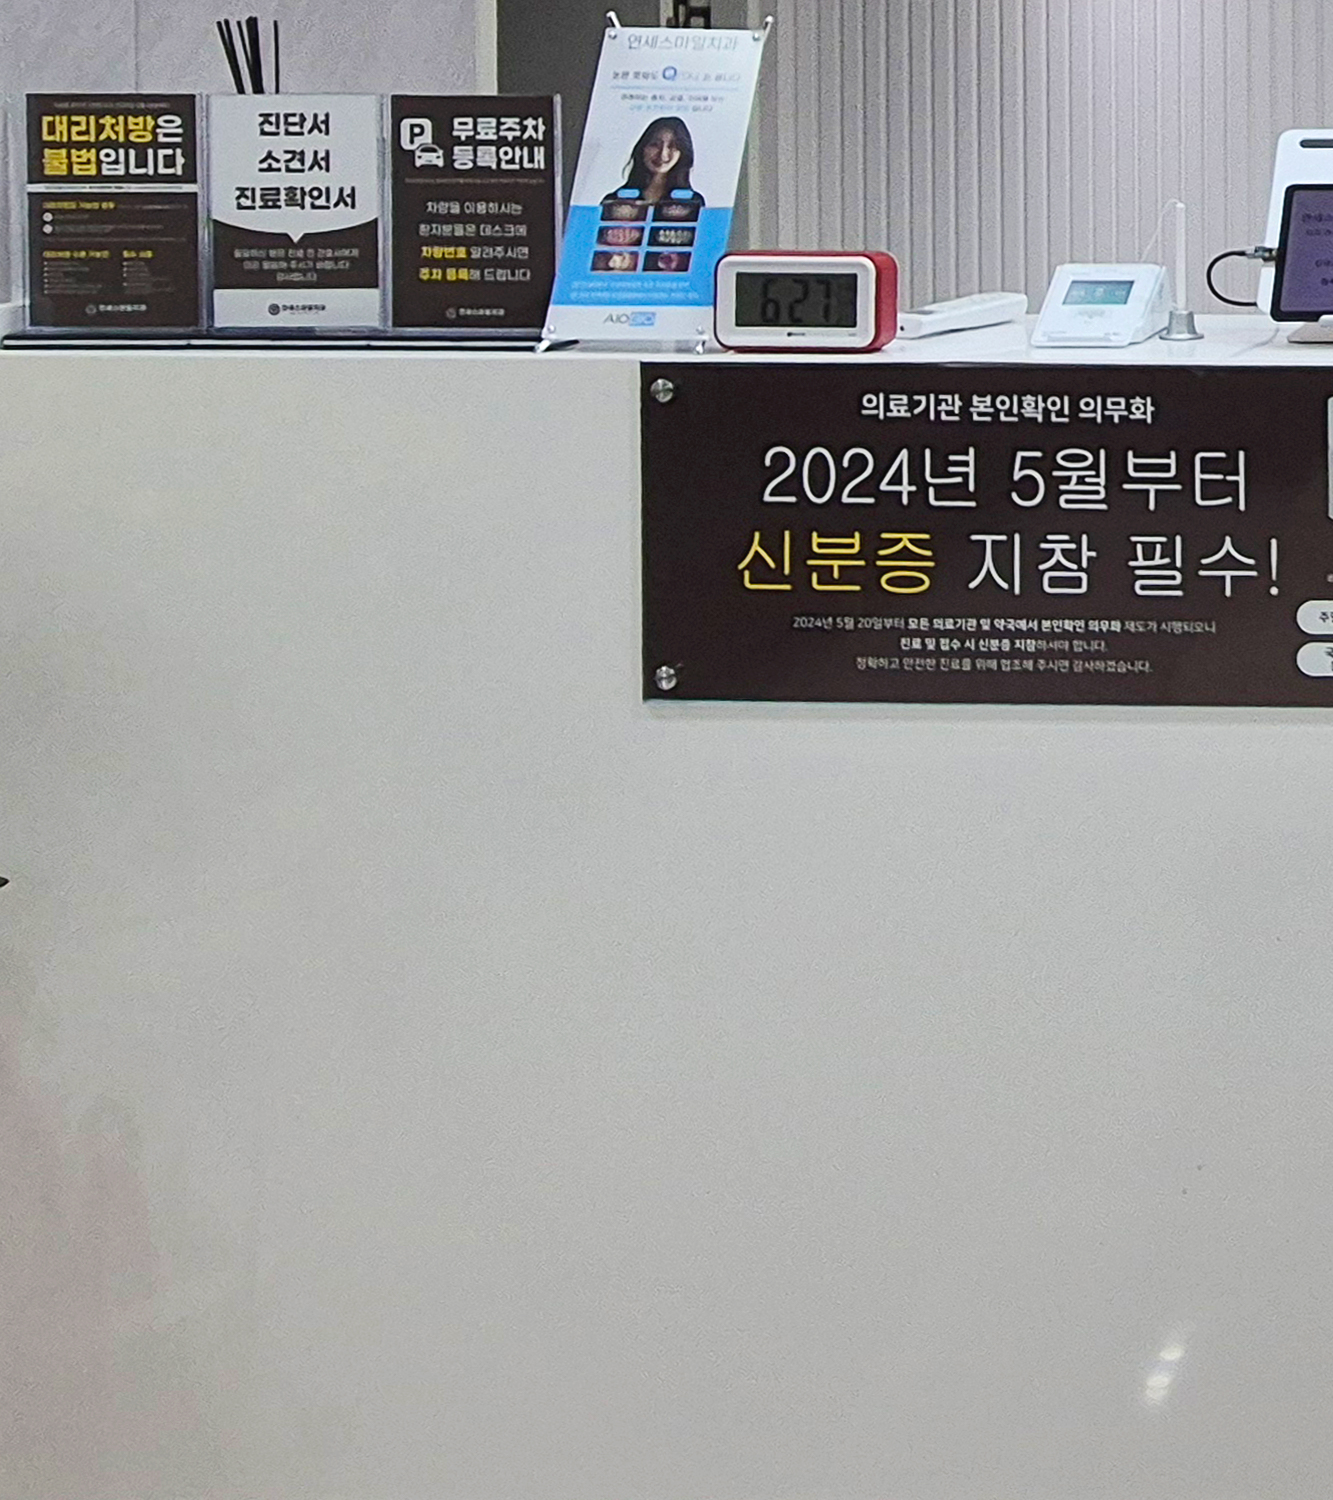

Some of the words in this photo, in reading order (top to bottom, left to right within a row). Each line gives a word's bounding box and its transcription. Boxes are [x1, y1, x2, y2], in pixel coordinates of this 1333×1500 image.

[628, 33, 738, 51] 연세스마일치과
[41, 115, 184, 143] 대리처방은
[257, 113, 330, 137] 진단서
[452, 116, 545, 141] 무료주차
[42, 148, 185, 176] 불법입니다
[257, 150, 330, 174] 소견서
[452, 144, 545, 171] 등록안내
[234, 185, 357, 211] 진료확인서
[421, 246, 467, 259] 차량번호
[484, 268, 530, 281] 드립니다
[861, 394, 961, 420] 의료기관
[969, 394, 1070, 423] 본인확인
[1078, 396, 1155, 424] 의무화
[762, 445, 977, 508] 2024년
[1010, 448, 1247, 511] 5월부터
[737, 530, 936, 592] 신분증
[968, 532, 1097, 596] 지참
[1127, 535, 1279, 597] 필수!
[793, 616, 833, 629] 2024년
[836, 616, 855, 629] 5월
[858, 616, 904, 629] 20일부터
[907, 616, 929, 629] 모든
[933, 616, 977, 629] 의료기관
[980, 618, 990, 630] 및
[994, 619, 1038, 632] 약국에서
[1042, 619, 1087, 632] 본인확인
[1088, 619, 1121, 632] 의무화
[1123, 621, 1157, 632] 제도가
[900, 637, 922, 650] 진료
[925, 637, 936, 650] 및
[939, 637, 961, 650] 접수
[964, 637, 975, 650] 시
[978, 637, 1009, 650] 신분증
[856, 657, 899, 671] 정확하고
[903, 657, 936, 671] 안전한
[940, 657, 971, 671] 진료를
[975, 657, 997, 671] 위해
[1000, 659, 1033, 672] 협조해
[1037, 659, 1069, 672] 주시면
